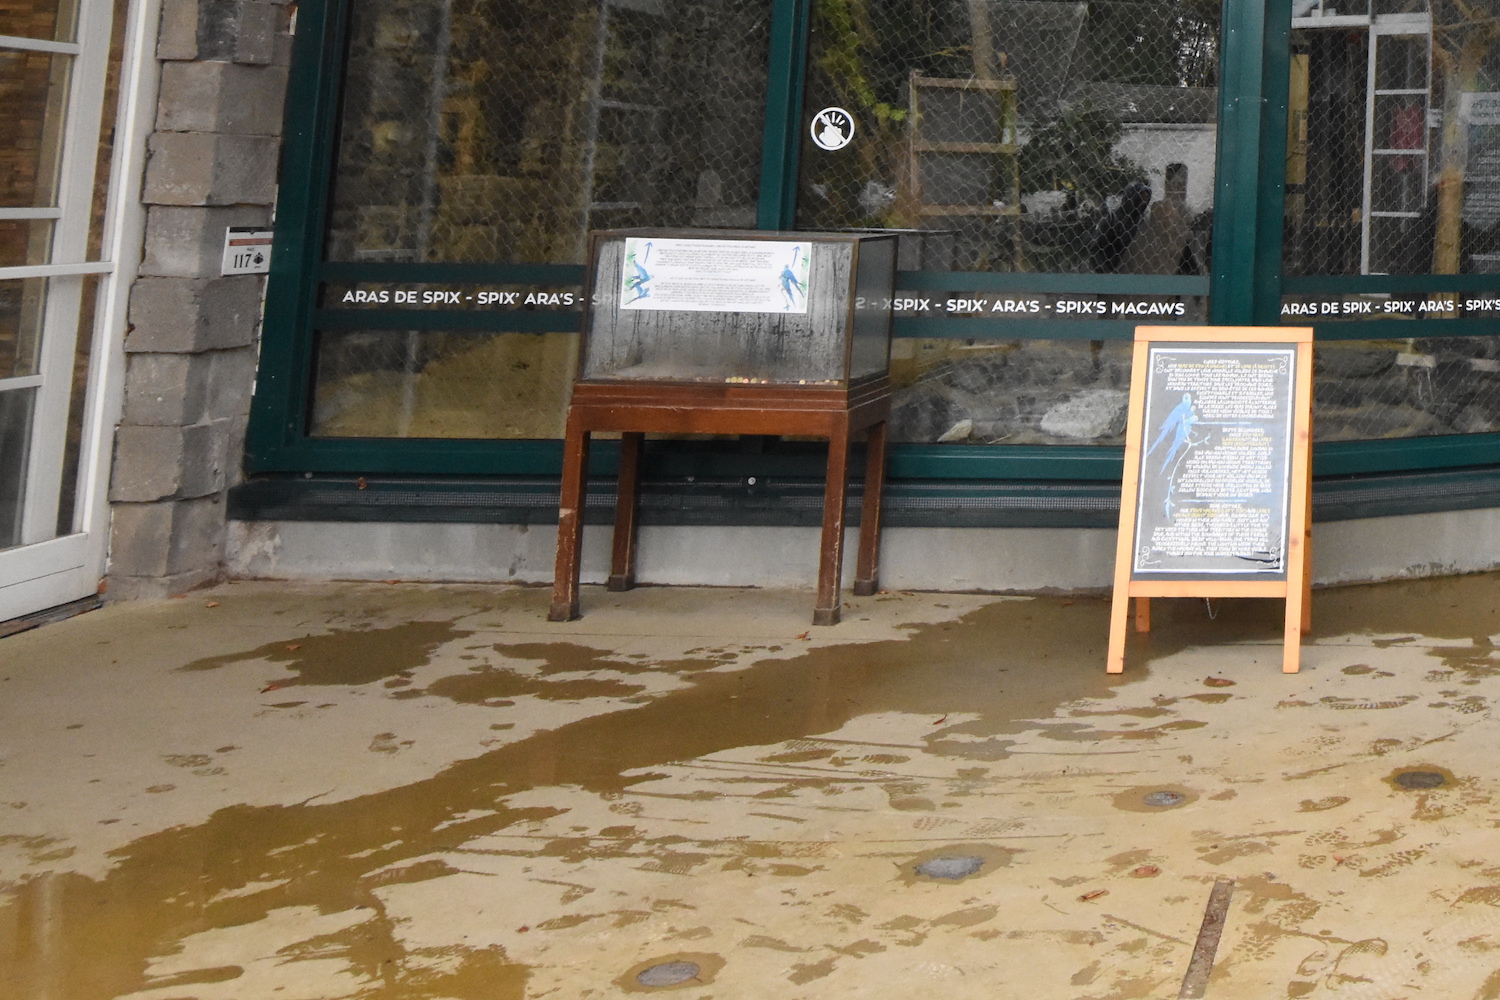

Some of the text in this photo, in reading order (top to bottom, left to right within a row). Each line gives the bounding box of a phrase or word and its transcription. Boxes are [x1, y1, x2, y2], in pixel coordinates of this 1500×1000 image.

[342, 290, 390, 303] ARAS
[394, 291, 418, 303] DE
[422, 291, 461, 304] SPIX
[477, 292, 520, 305] SPIX'
[523, 292, 574, 305] ARA'S
[946, 299, 987, 312] SPIX'
[991, 299, 1040, 313] ARA'S
[1056, 300, 1107, 314] SPIX'S
[1111, 302, 1185, 316] MACAWS
[1281, 303, 1317, 315] ARAS
[1321, 303, 1339, 314] DE
[1343, 302, 1372, 313] SPIX
[1384, 301, 1415, 313] SPIX'
[1418, 300, 1454, 312] ARA'S
